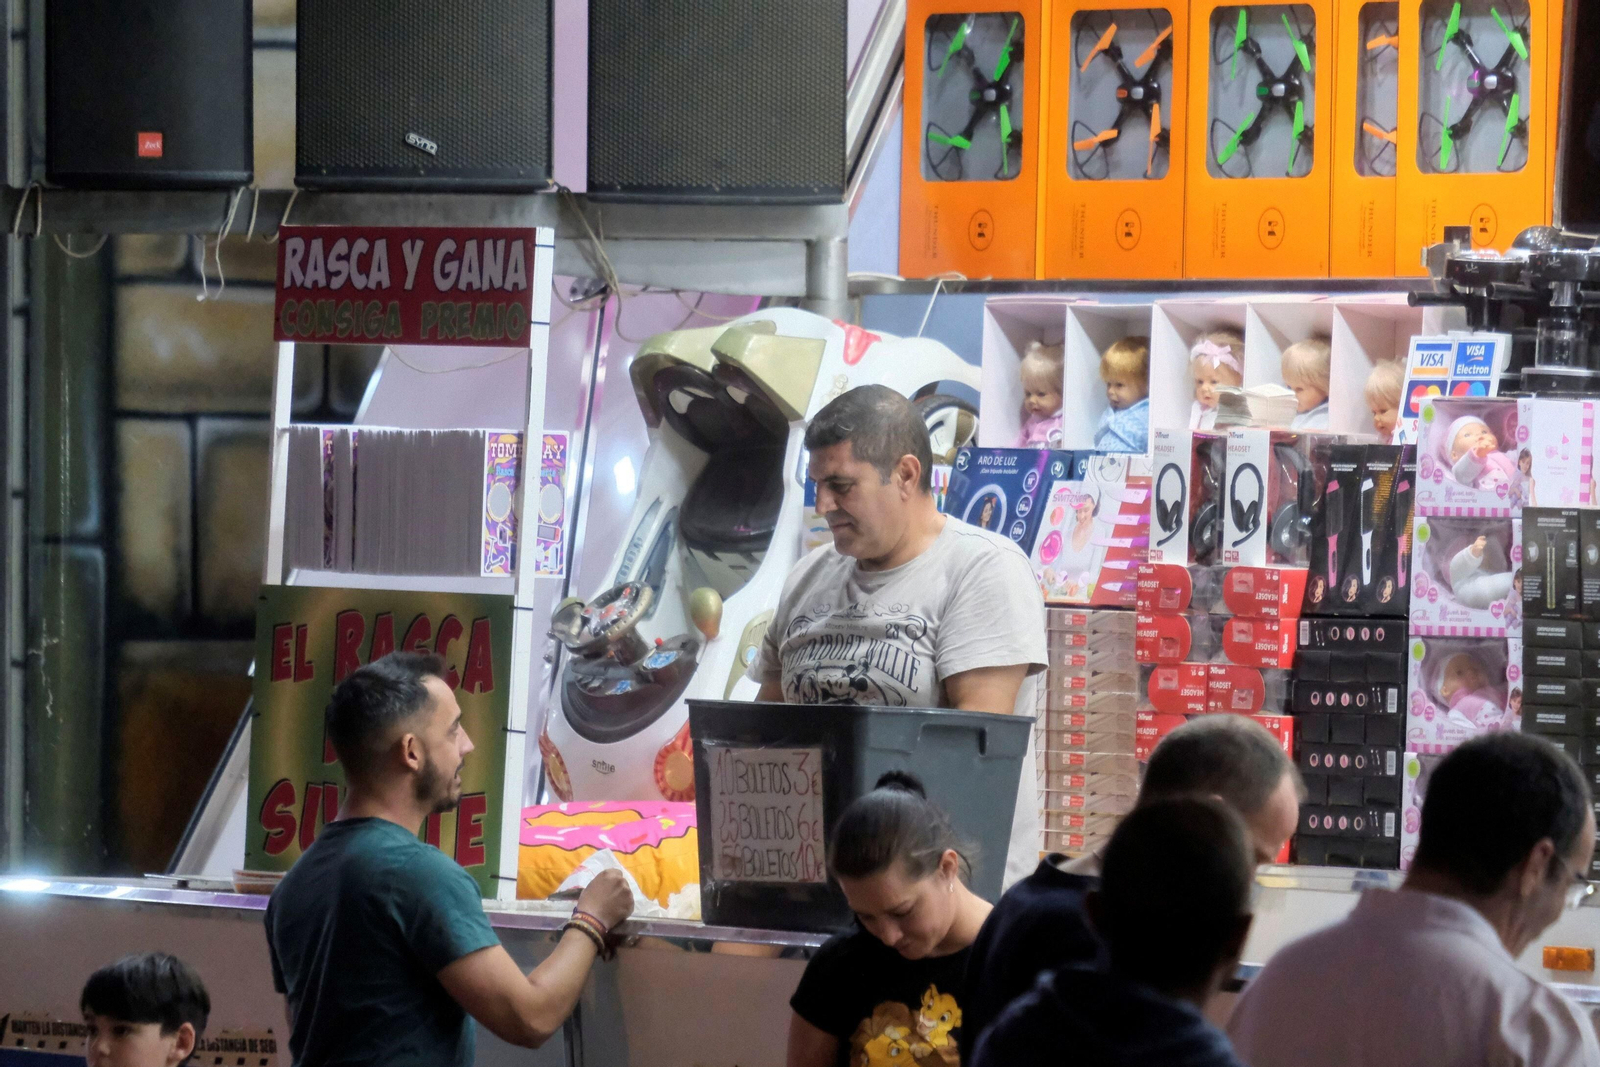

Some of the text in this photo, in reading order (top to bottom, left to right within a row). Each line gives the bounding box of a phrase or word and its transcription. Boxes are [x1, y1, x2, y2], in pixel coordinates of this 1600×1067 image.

[283, 237, 528, 293] RASCA Y GANA
[280, 299, 528, 341] CONSIGA PREMIO
[1466, 345, 1486, 356] VISA
[1420, 352, 1444, 367] VISA
[1456, 364, 1490, 376] Electron
[1154, 445, 1175, 453] HEADSET
[1227, 445, 1250, 453] HEADSET
[977, 455, 1018, 467] ARO DE LUZ
[1139, 565, 1154, 574] Trust
[1255, 592, 1279, 600] HEADSET
[1138, 615, 1153, 624] Trust
[885, 623, 900, 640] 28
[1255, 643, 1279, 651] HEADSET
[270, 622, 315, 684] EL
[866, 637, 921, 693] WILLIE
[1210, 666, 1226, 675] Trust
[1209, 681, 1232, 689] HEADSET
[1180, 689, 1205, 697] HEADSET
[1138, 712, 1153, 721] Trust
[716, 749, 734, 795] 10
[735, 759, 792, 796] BOLETOS
[719, 801, 739, 844] 25
[739, 803, 795, 841] BOLETOS
[743, 846, 798, 880] BOLETOS
